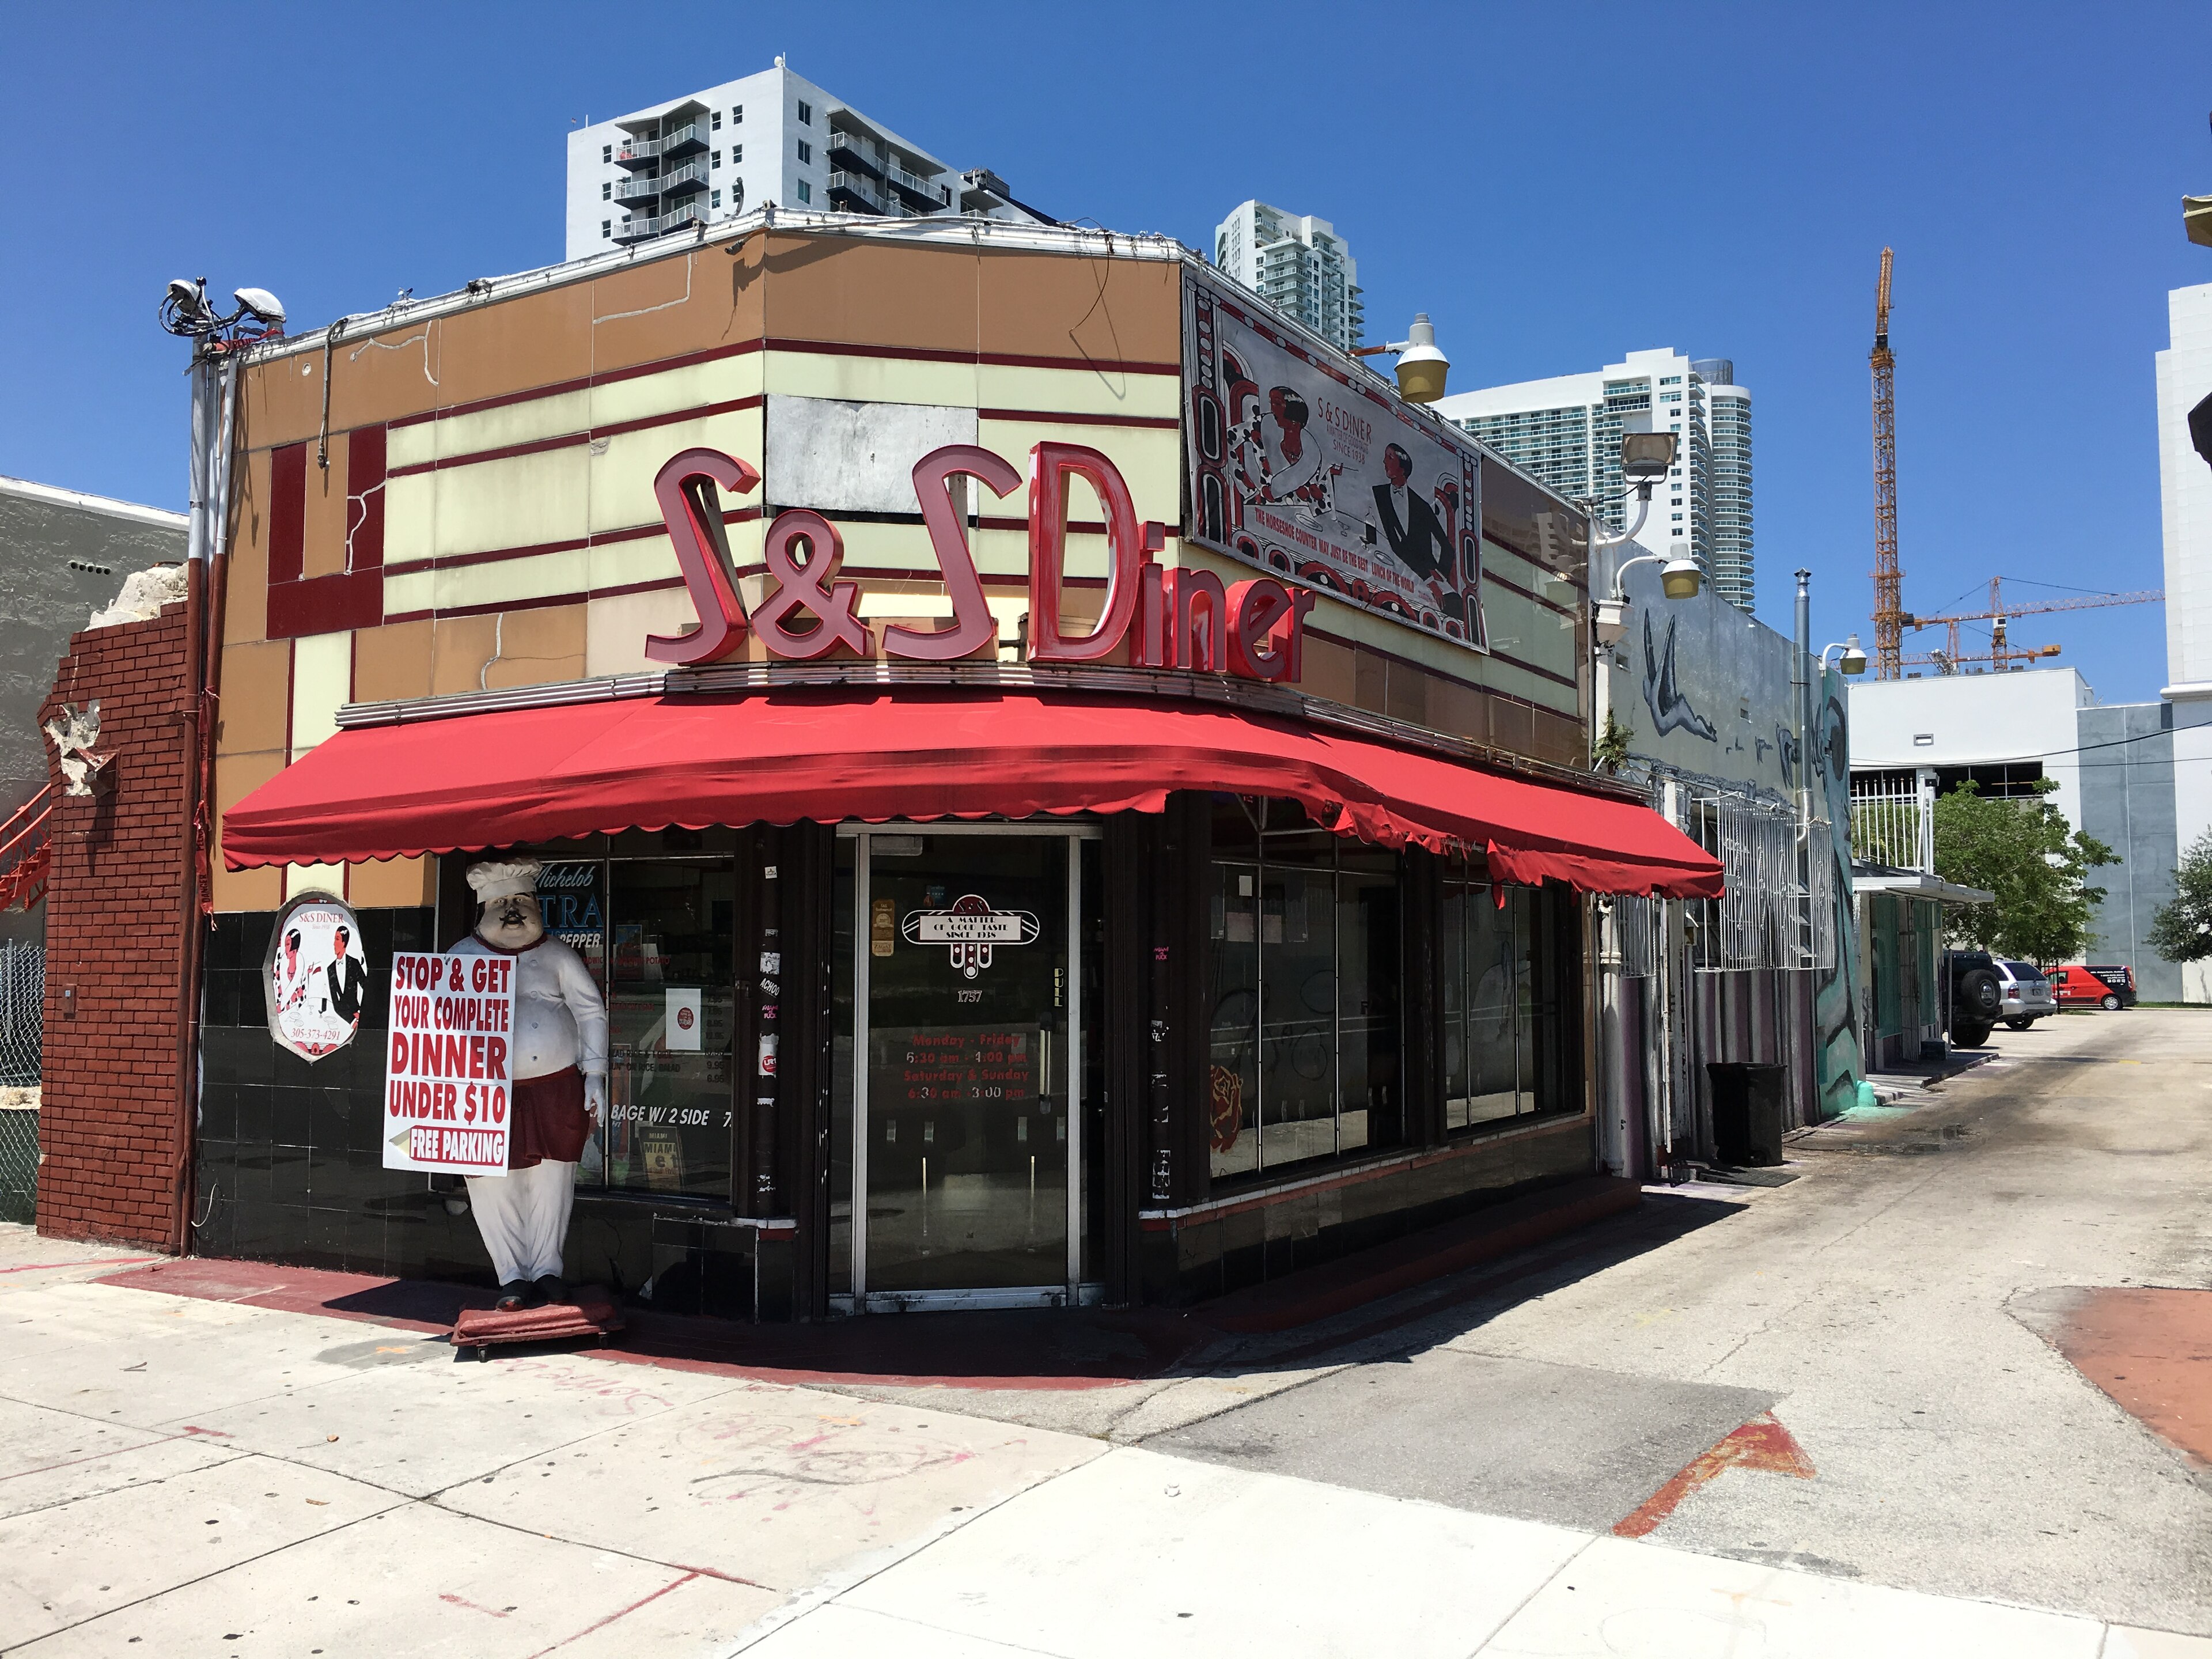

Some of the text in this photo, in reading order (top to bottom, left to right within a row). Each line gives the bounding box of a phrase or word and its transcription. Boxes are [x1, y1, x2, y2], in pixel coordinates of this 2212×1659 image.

[1317, 397, 1372, 445] S & S DINER
[1333, 439, 1365, 465] SINCE 1938
[1255, 507, 1415, 594] THE HORSESHOE COUNTER MAY JUST BE THE BEST LUNCH OF THE WORLD
[199, 874, 210, 903] DANGER
[299, 912, 344, 923] S&S DINER
[539, 893, 604, 929] TRA
[395, 956, 511, 993] STOP & GET
[759, 978, 780, 996] ACHOO
[956, 990, 983, 1003] 1757
[394, 995, 509, 1032] YOUR COMPLETE
[291, 1028, 340, 1040] 305-373-4291
[912, 1033, 966, 1048] Monday
[979, 1033, 1022, 1048] Friday
[391, 1032, 507, 1080] DINNER
[706, 1060, 724, 1070] 9.95
[706, 1074, 724, 1084] 6.95
[903, 1068, 1030, 1084] Saturday & Sunday
[389, 1080, 506, 1126] UNDER $10
[649, 1106, 668, 1123] W/
[668, 1107, 678, 1124] 2
[680, 1108, 710, 1126] SIDE
[410, 1128, 504, 1164] FREE PARKING
[645, 1143, 676, 1153] MIAMI
